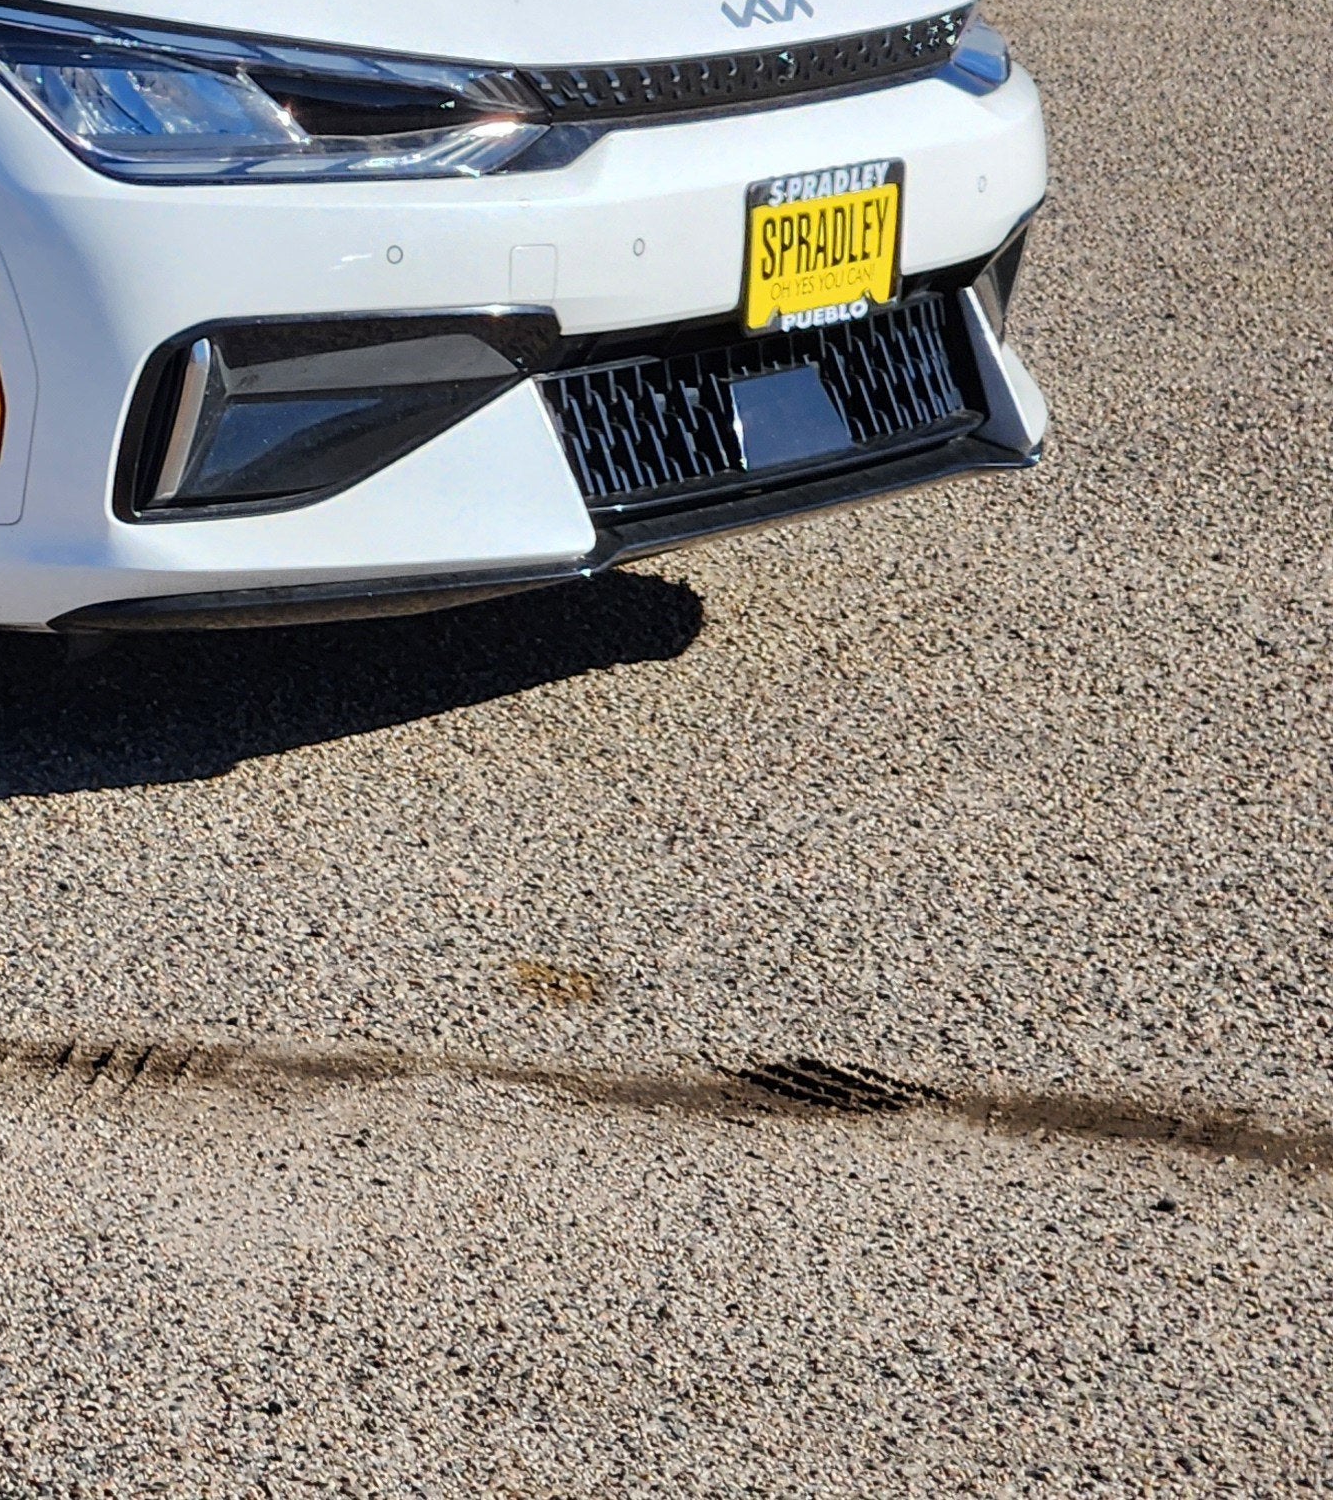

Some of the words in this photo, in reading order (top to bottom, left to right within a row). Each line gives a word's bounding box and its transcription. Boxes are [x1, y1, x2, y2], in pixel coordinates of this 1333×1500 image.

[768, 160, 890, 207] SPRADLEY
[760, 196, 890, 281] SPRADLEY
[770, 282, 790, 301] OH
[796, 275, 815, 297] YES
[820, 269, 844, 292] YOU
[781, 299, 870, 333] PUEBLO
